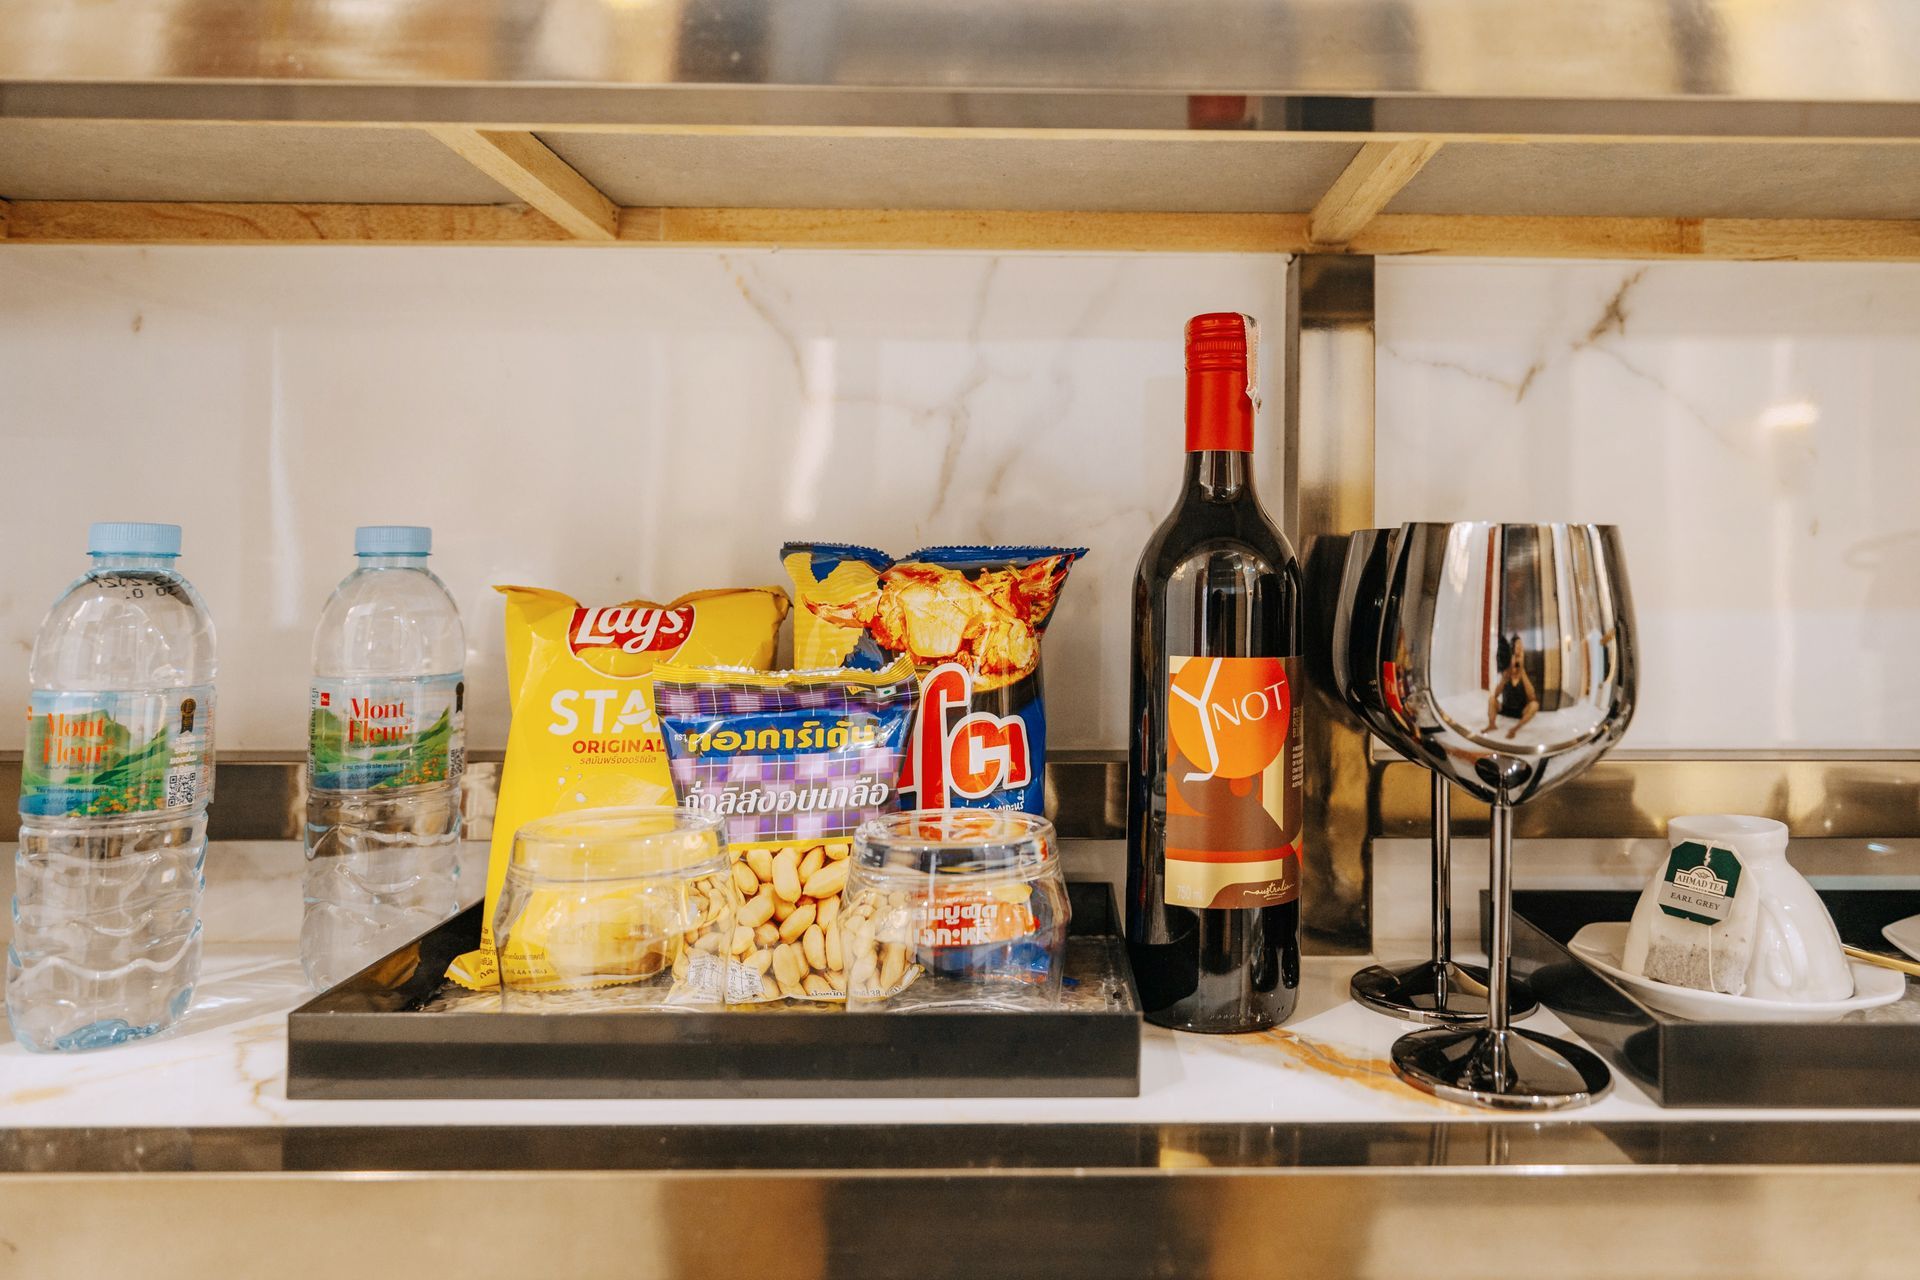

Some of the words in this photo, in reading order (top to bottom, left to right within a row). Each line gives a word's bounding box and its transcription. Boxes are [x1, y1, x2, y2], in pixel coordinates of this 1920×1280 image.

[351, 698, 406, 718] Mont
[548, 689, 661, 735] STA
[47, 713, 105, 737] Mont
[349, 719, 409, 744] Fleur
[43, 738, 109, 764] Fleur
[572, 740, 665, 754] ORIGINAL
[685, 777, 889, 815] ถั่วลิสงอบเกลือ
[1676, 874, 1708, 887] AHMAD
[1709, 881, 1725, 893] TEA
[1670, 892, 1693, 904] EARL
[1695, 898, 1720, 911] GREY
